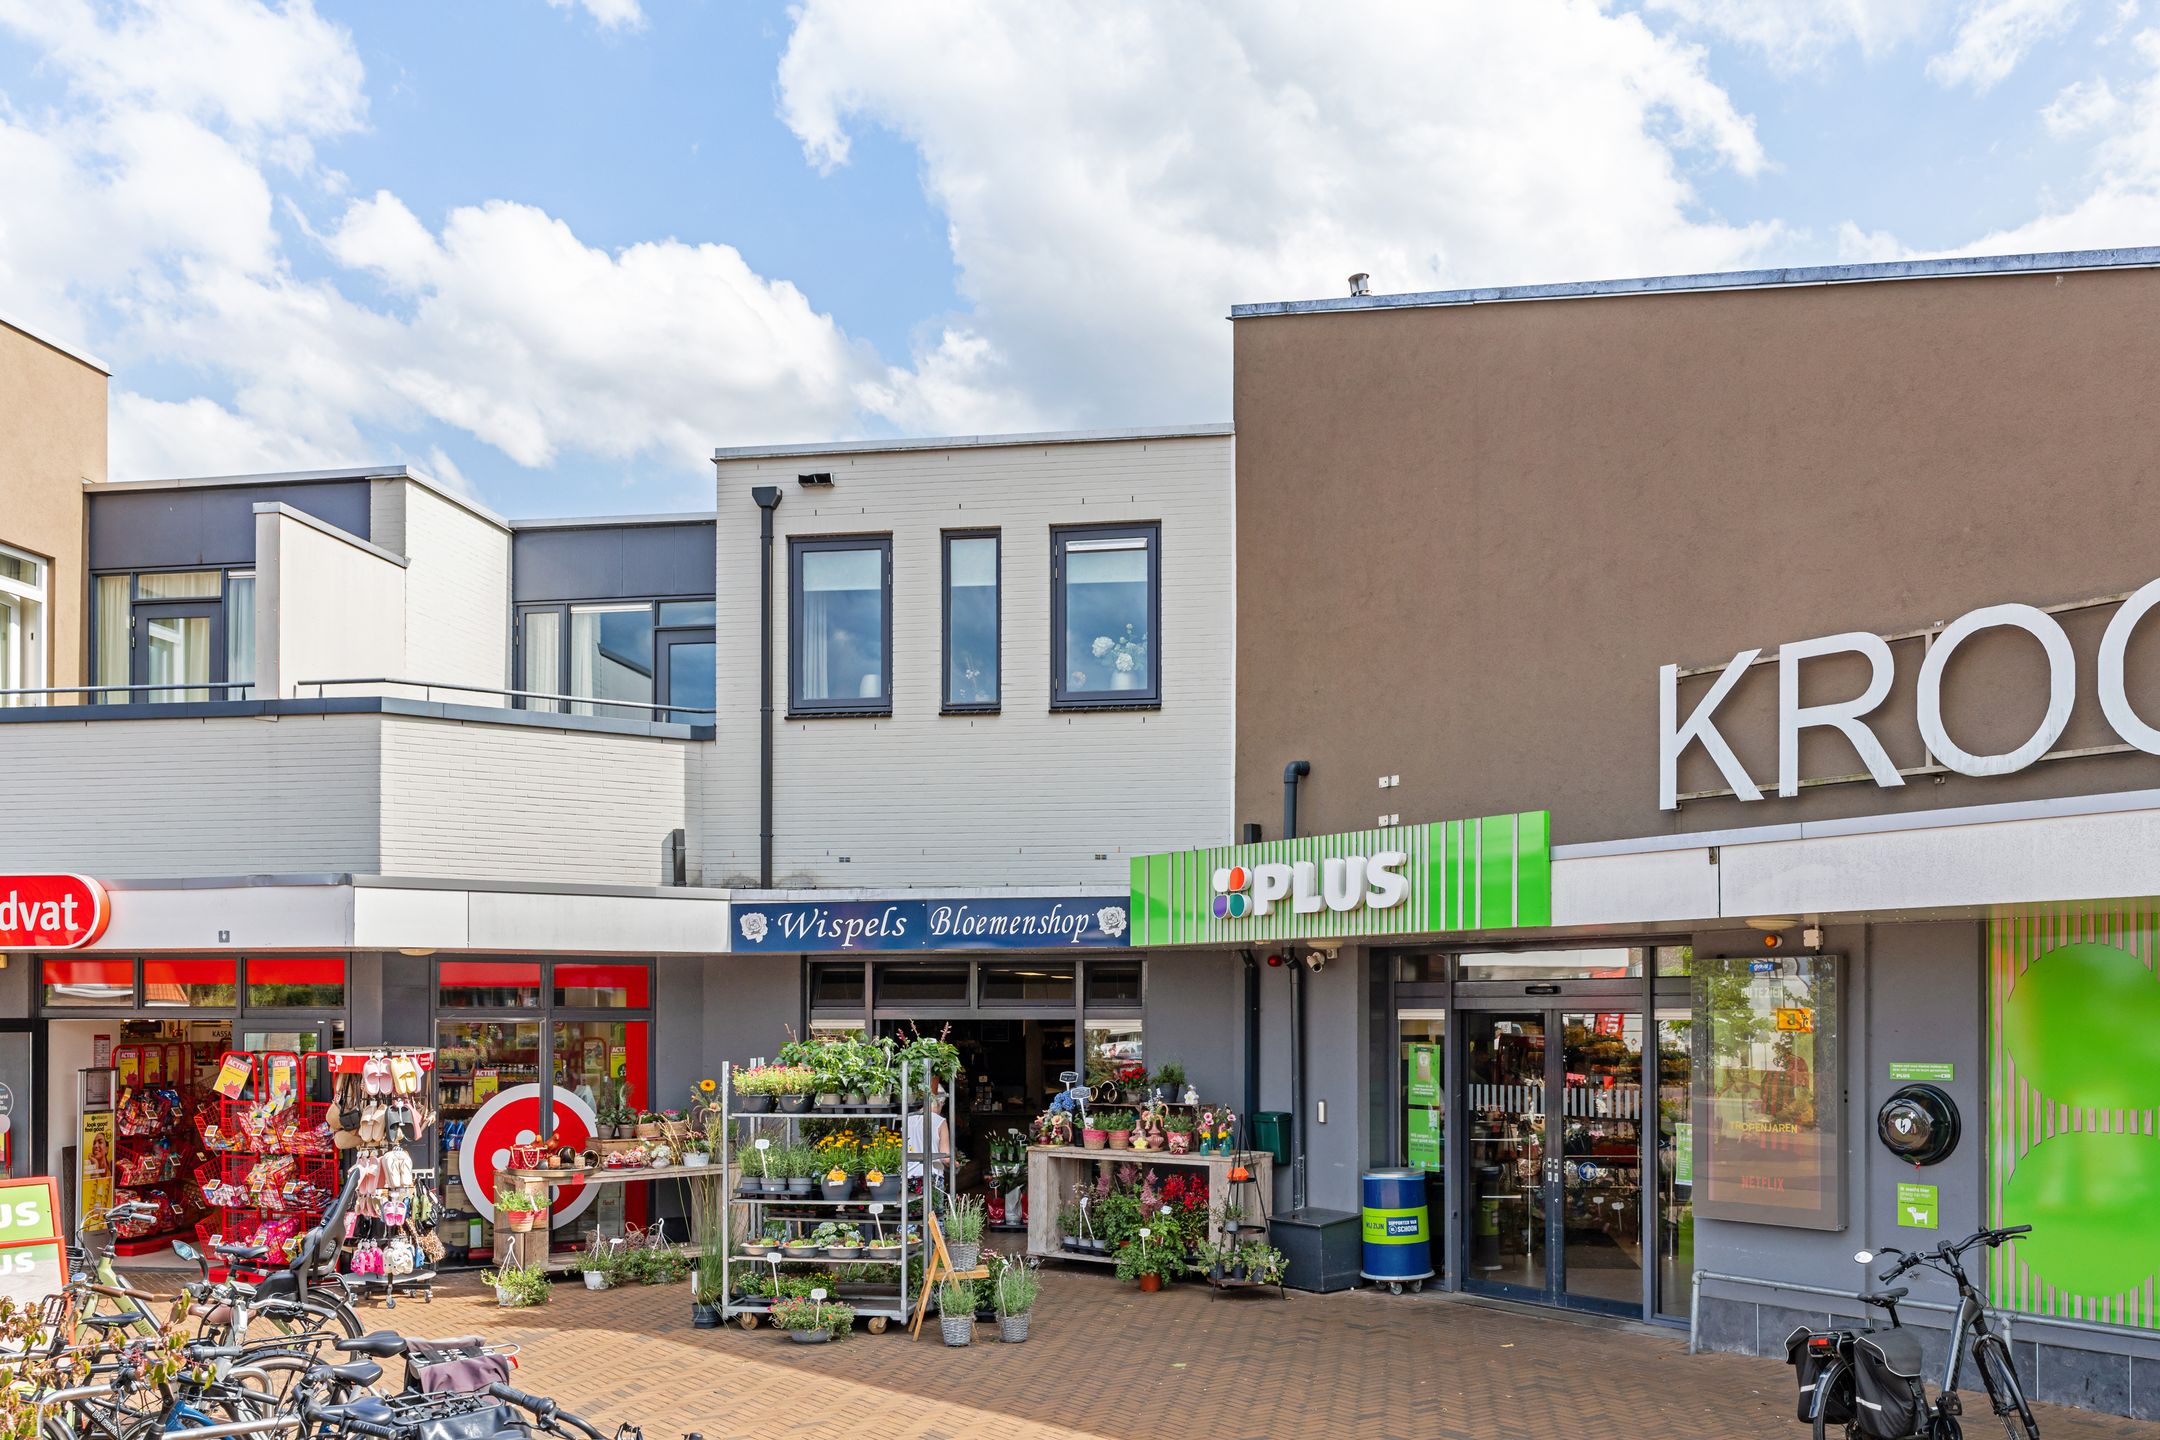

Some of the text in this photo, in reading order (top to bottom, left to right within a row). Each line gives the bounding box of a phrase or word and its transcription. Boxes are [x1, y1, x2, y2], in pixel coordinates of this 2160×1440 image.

[1254, 851, 1409, 916] PLUS
[777, 903, 1090, 946] Wispels Bloemenshop
[211, 1030, 232, 1038] KASSA
[1741, 1176, 1784, 1192] NETFLIX
[1397, 1225, 1418, 1233] SCHOON
